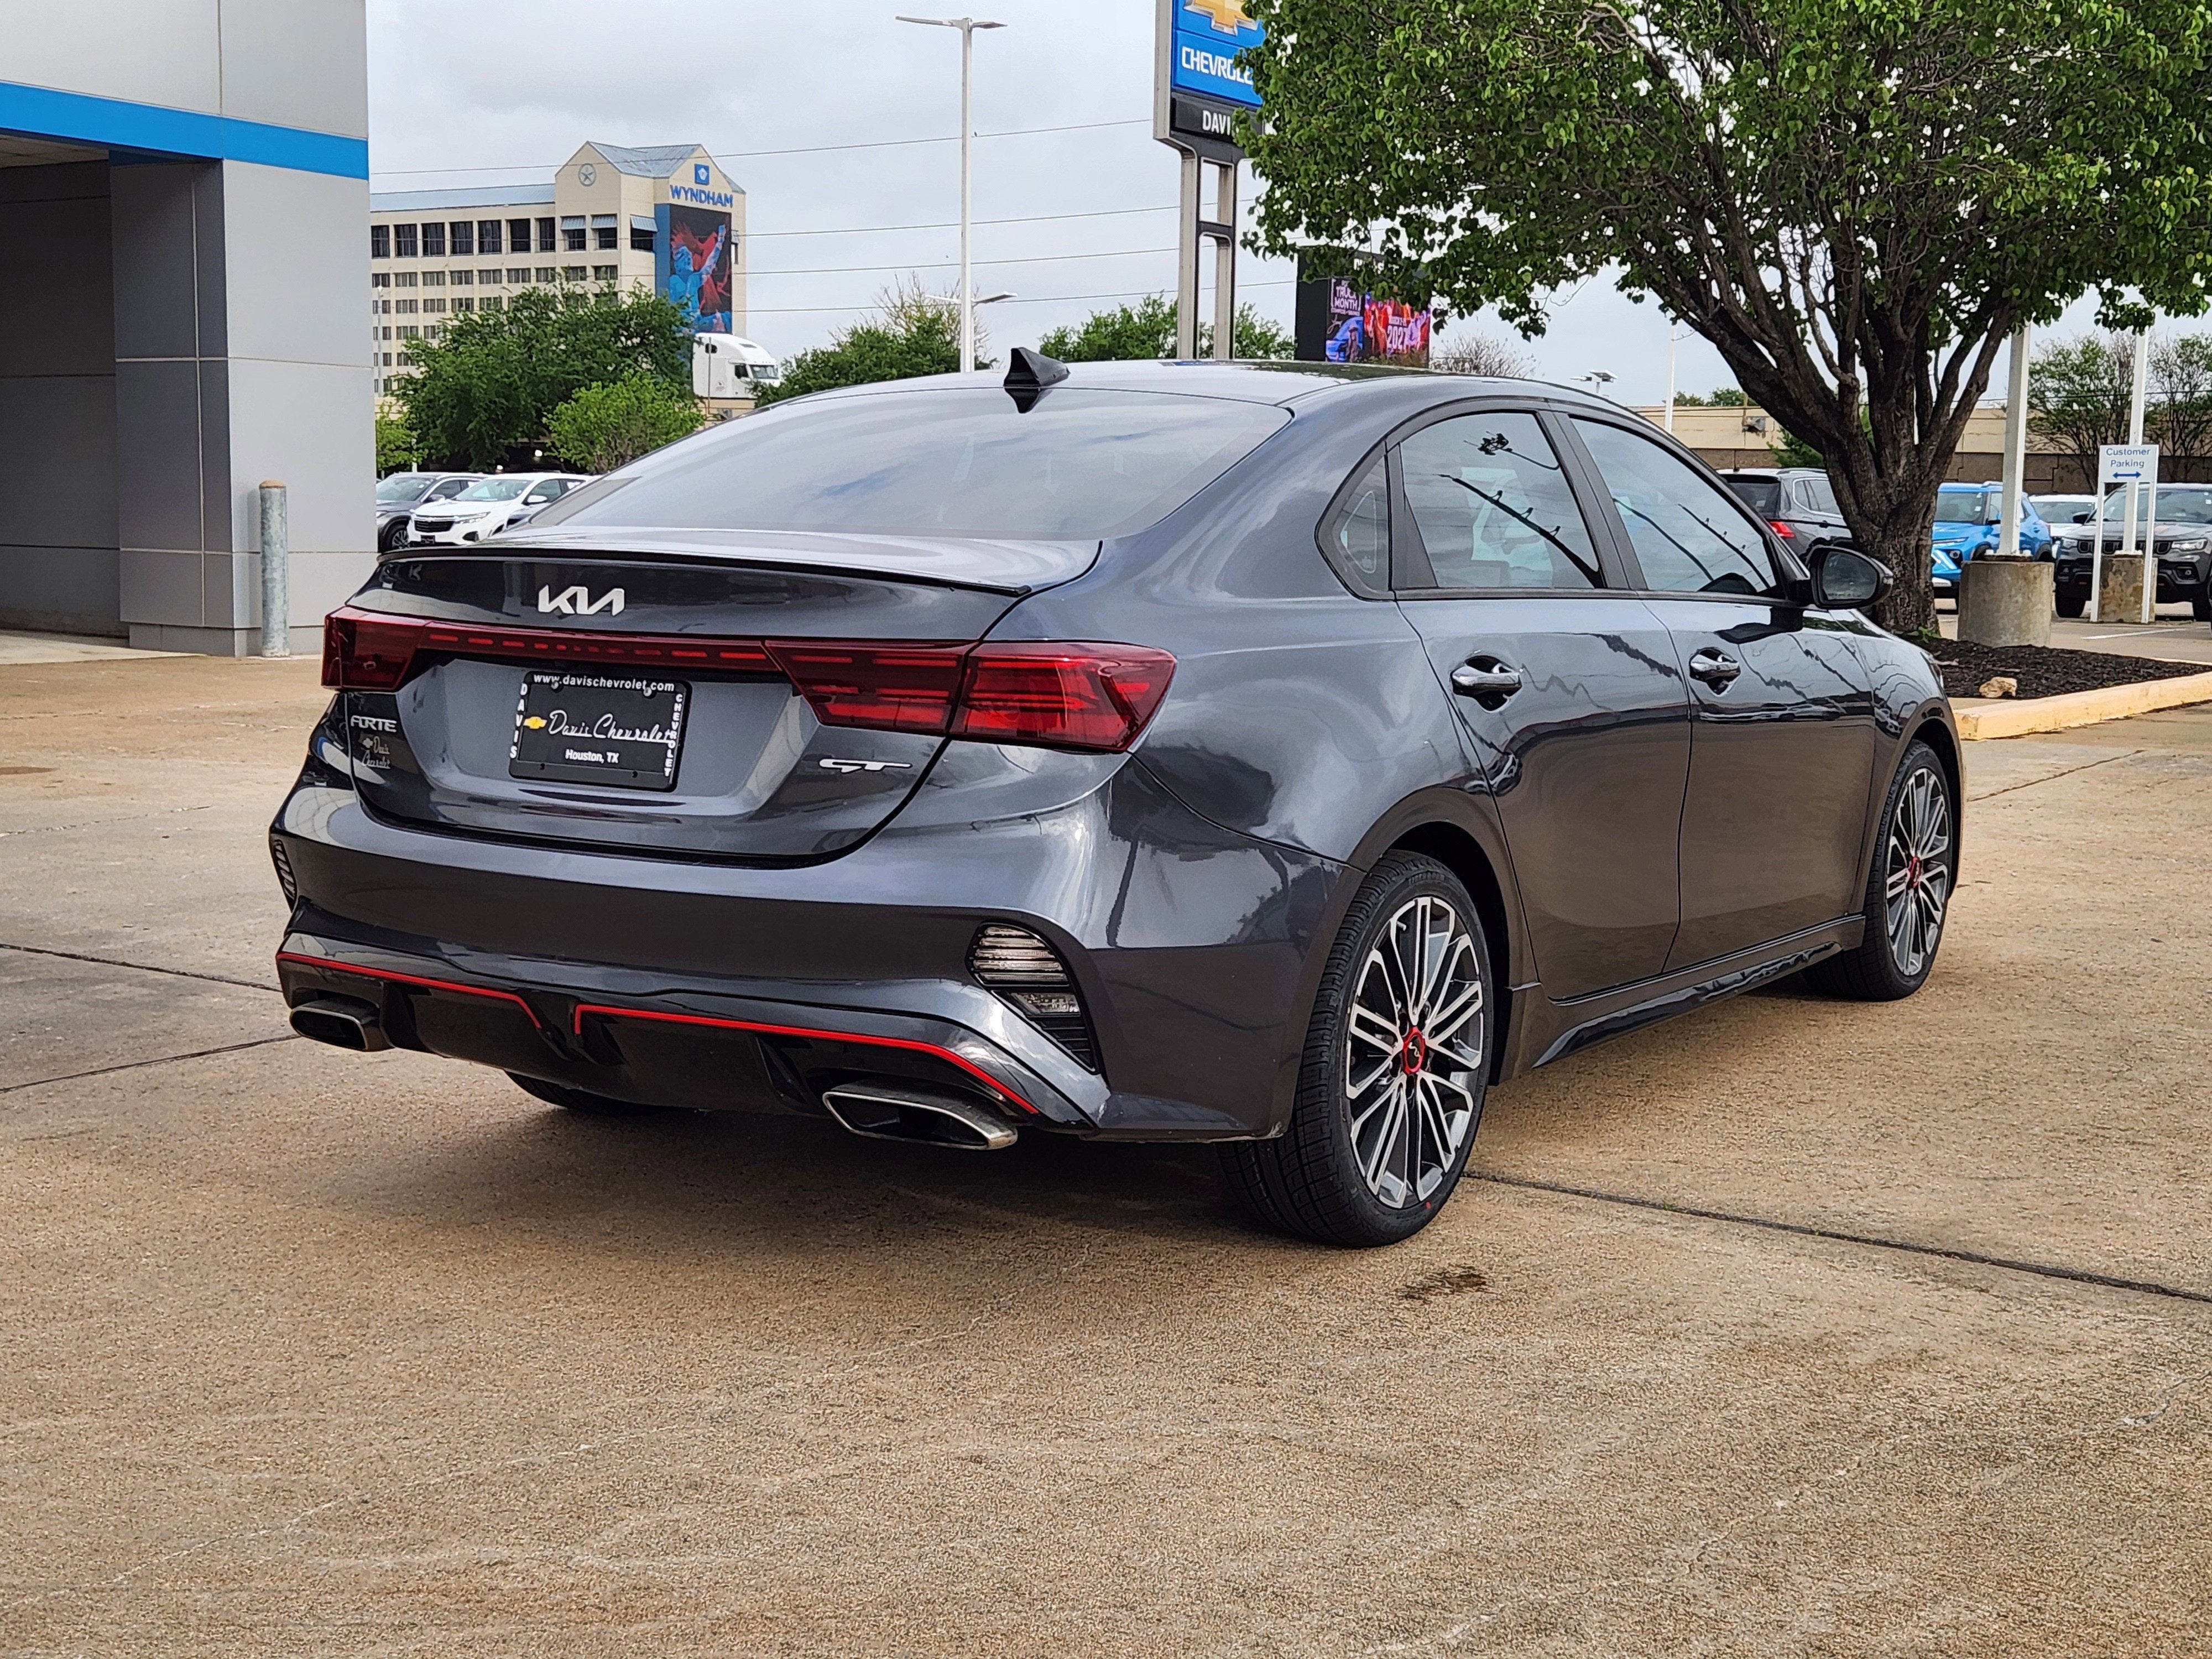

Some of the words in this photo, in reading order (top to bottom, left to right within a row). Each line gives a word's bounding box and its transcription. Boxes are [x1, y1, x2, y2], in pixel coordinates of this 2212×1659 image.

[1182, 46, 1254, 85] CHEVROLE
[1202, 109, 1232, 136] DAVI
[670, 185, 733, 208] WYNDHAM
[1334, 296, 1358, 311] MONTH
[2106, 448, 2151, 456] Customer
[2110, 459, 2145, 468] Parking
[538, 584, 625, 617] KIA
[533, 674, 675, 692] www.davischevroletcom
[350, 715, 398, 733] FORTE
[509, 683, 528, 759] DAVIS
[548, 709, 592, 737] Davis
[593, 713, 671, 743] Chevrolet
[662, 693, 684, 778] CHEVROLET
[565, 749, 604, 764] Houston,
[606, 752, 620, 764] TX
[818, 759, 912, 774] GT
